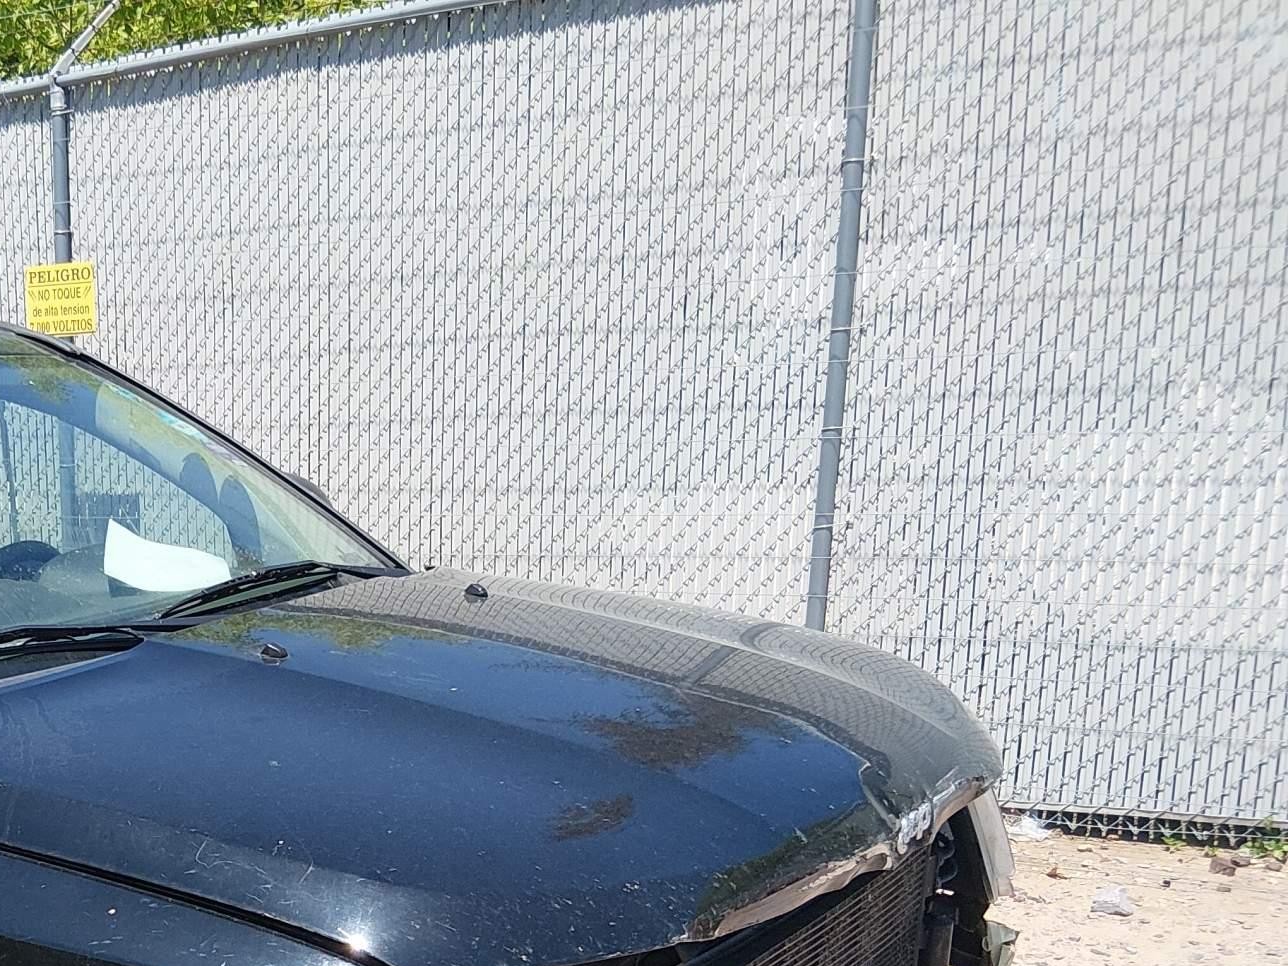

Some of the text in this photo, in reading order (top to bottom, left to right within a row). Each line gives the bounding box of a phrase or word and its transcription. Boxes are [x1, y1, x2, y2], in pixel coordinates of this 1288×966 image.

[29, 267, 91, 284] PELIGRO
[38, 286, 82, 301] NO TOQUE
[32, 306, 43, 317] de
[44, 305, 59, 316] alta
[52, 319, 93, 332] VOLTIOS
